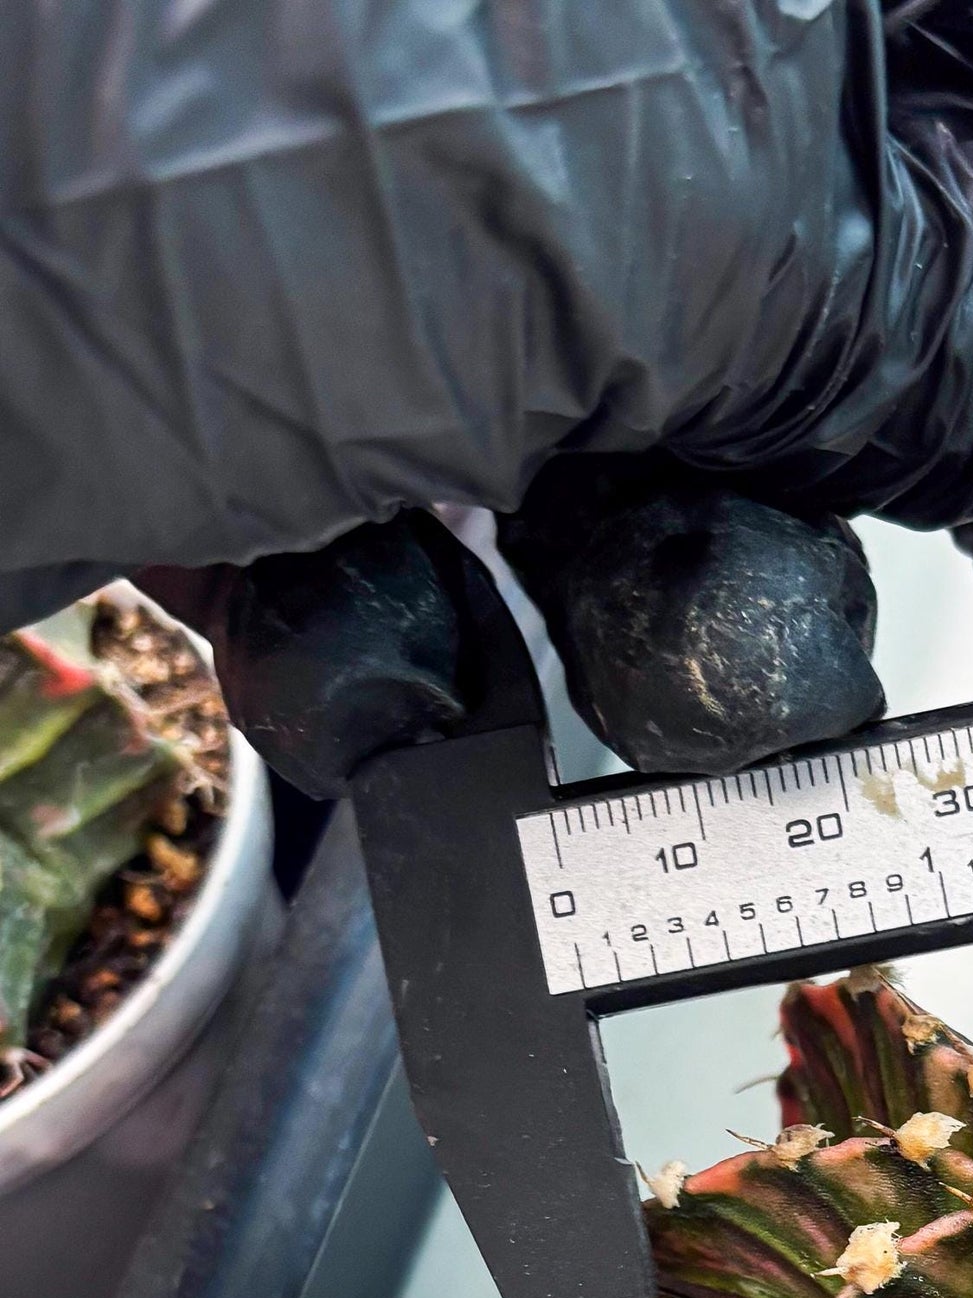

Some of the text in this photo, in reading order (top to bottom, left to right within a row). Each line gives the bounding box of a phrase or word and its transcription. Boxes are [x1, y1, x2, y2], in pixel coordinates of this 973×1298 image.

[550, 890, 576, 918] 0
[655, 842, 698, 873] 10
[785, 812, 844, 848] 20
[602, 931, 612, 947] 1
[631, 924, 648, 942] 2
[667, 917, 684, 934] 3
[704, 910, 720, 928] 4
[739, 903, 756, 921] 5
[776, 896, 793, 914] 6
[814, 888, 829, 906] 7
[848, 881, 868, 899] 8
[886, 874, 903, 892] 9
[919, 847, 935, 872] 1
